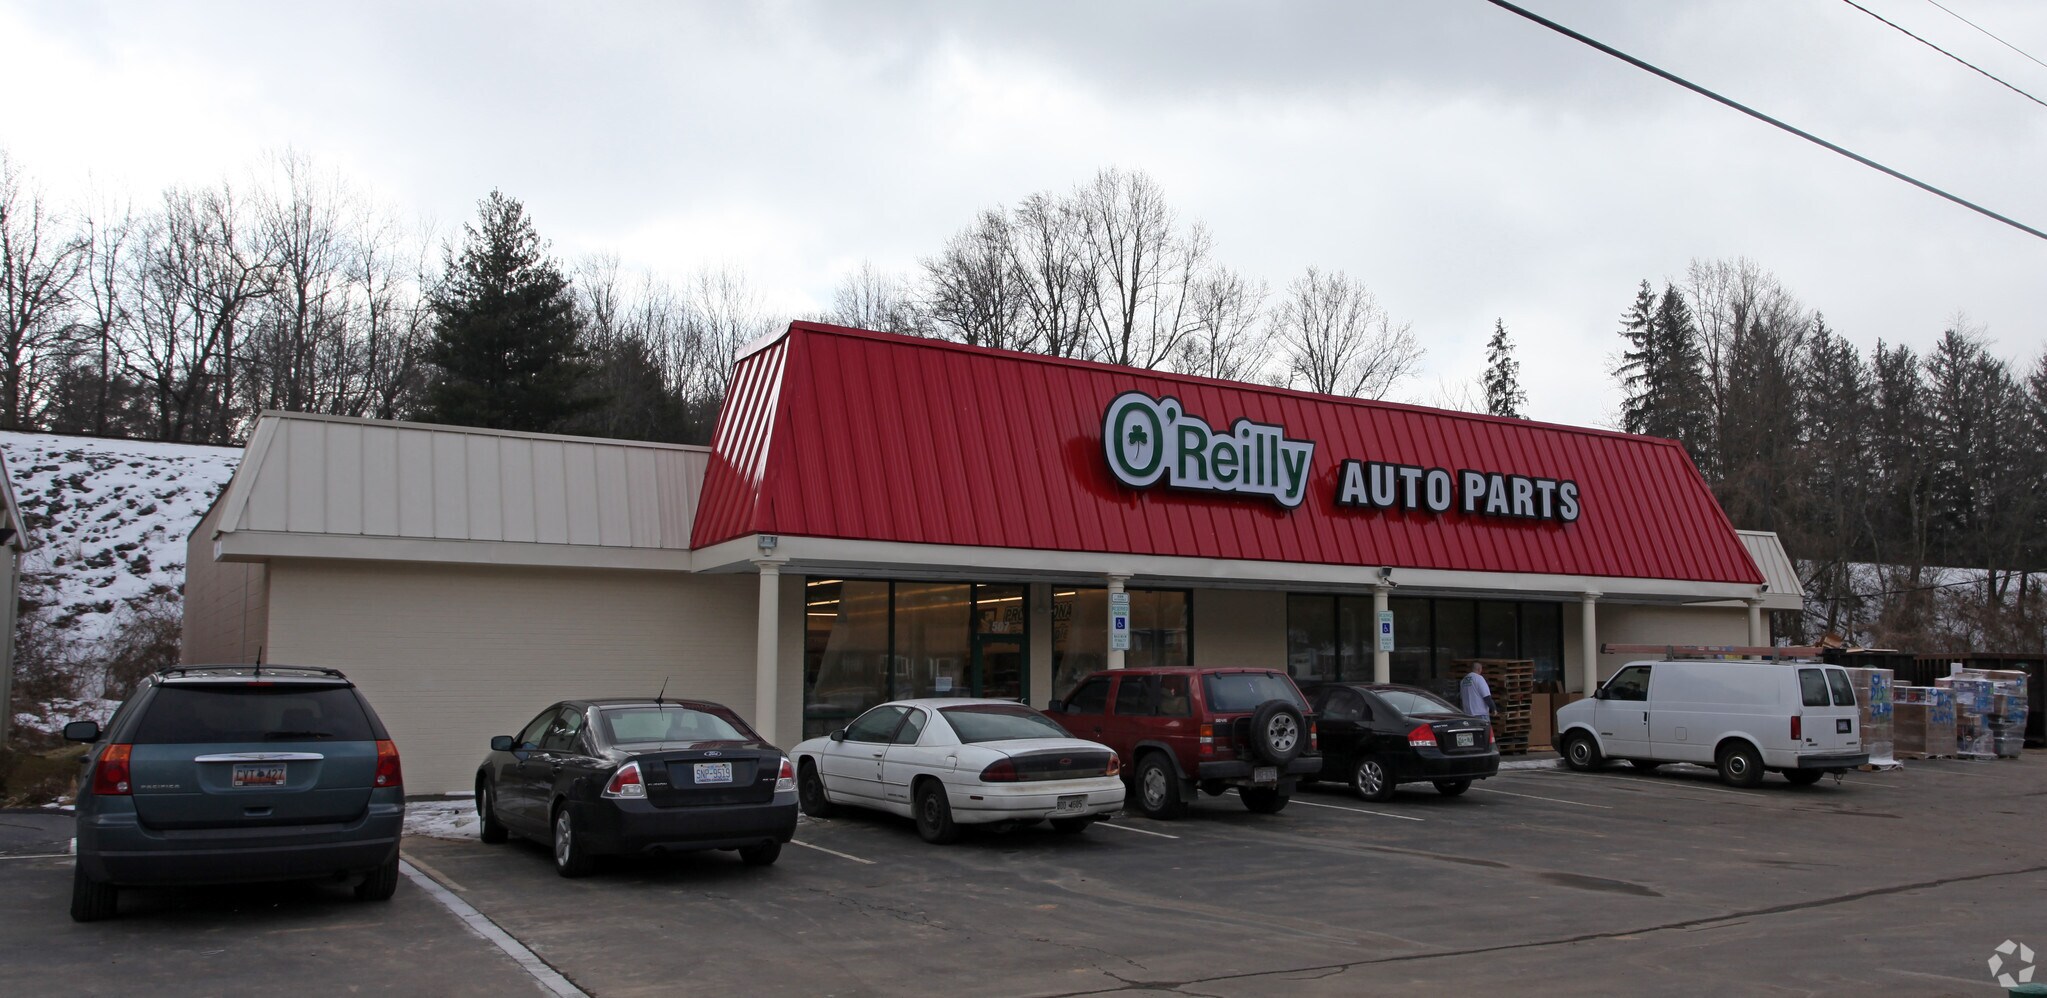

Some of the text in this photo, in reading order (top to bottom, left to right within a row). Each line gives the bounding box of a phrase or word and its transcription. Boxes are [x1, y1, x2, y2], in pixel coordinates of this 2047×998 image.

[1112, 401, 1307, 498] O'Reilly
[1341, 461, 1580, 521] AUTO PARTS
[992, 621, 1009, 632] 507
[696, 768, 731, 780] SNP-9519
